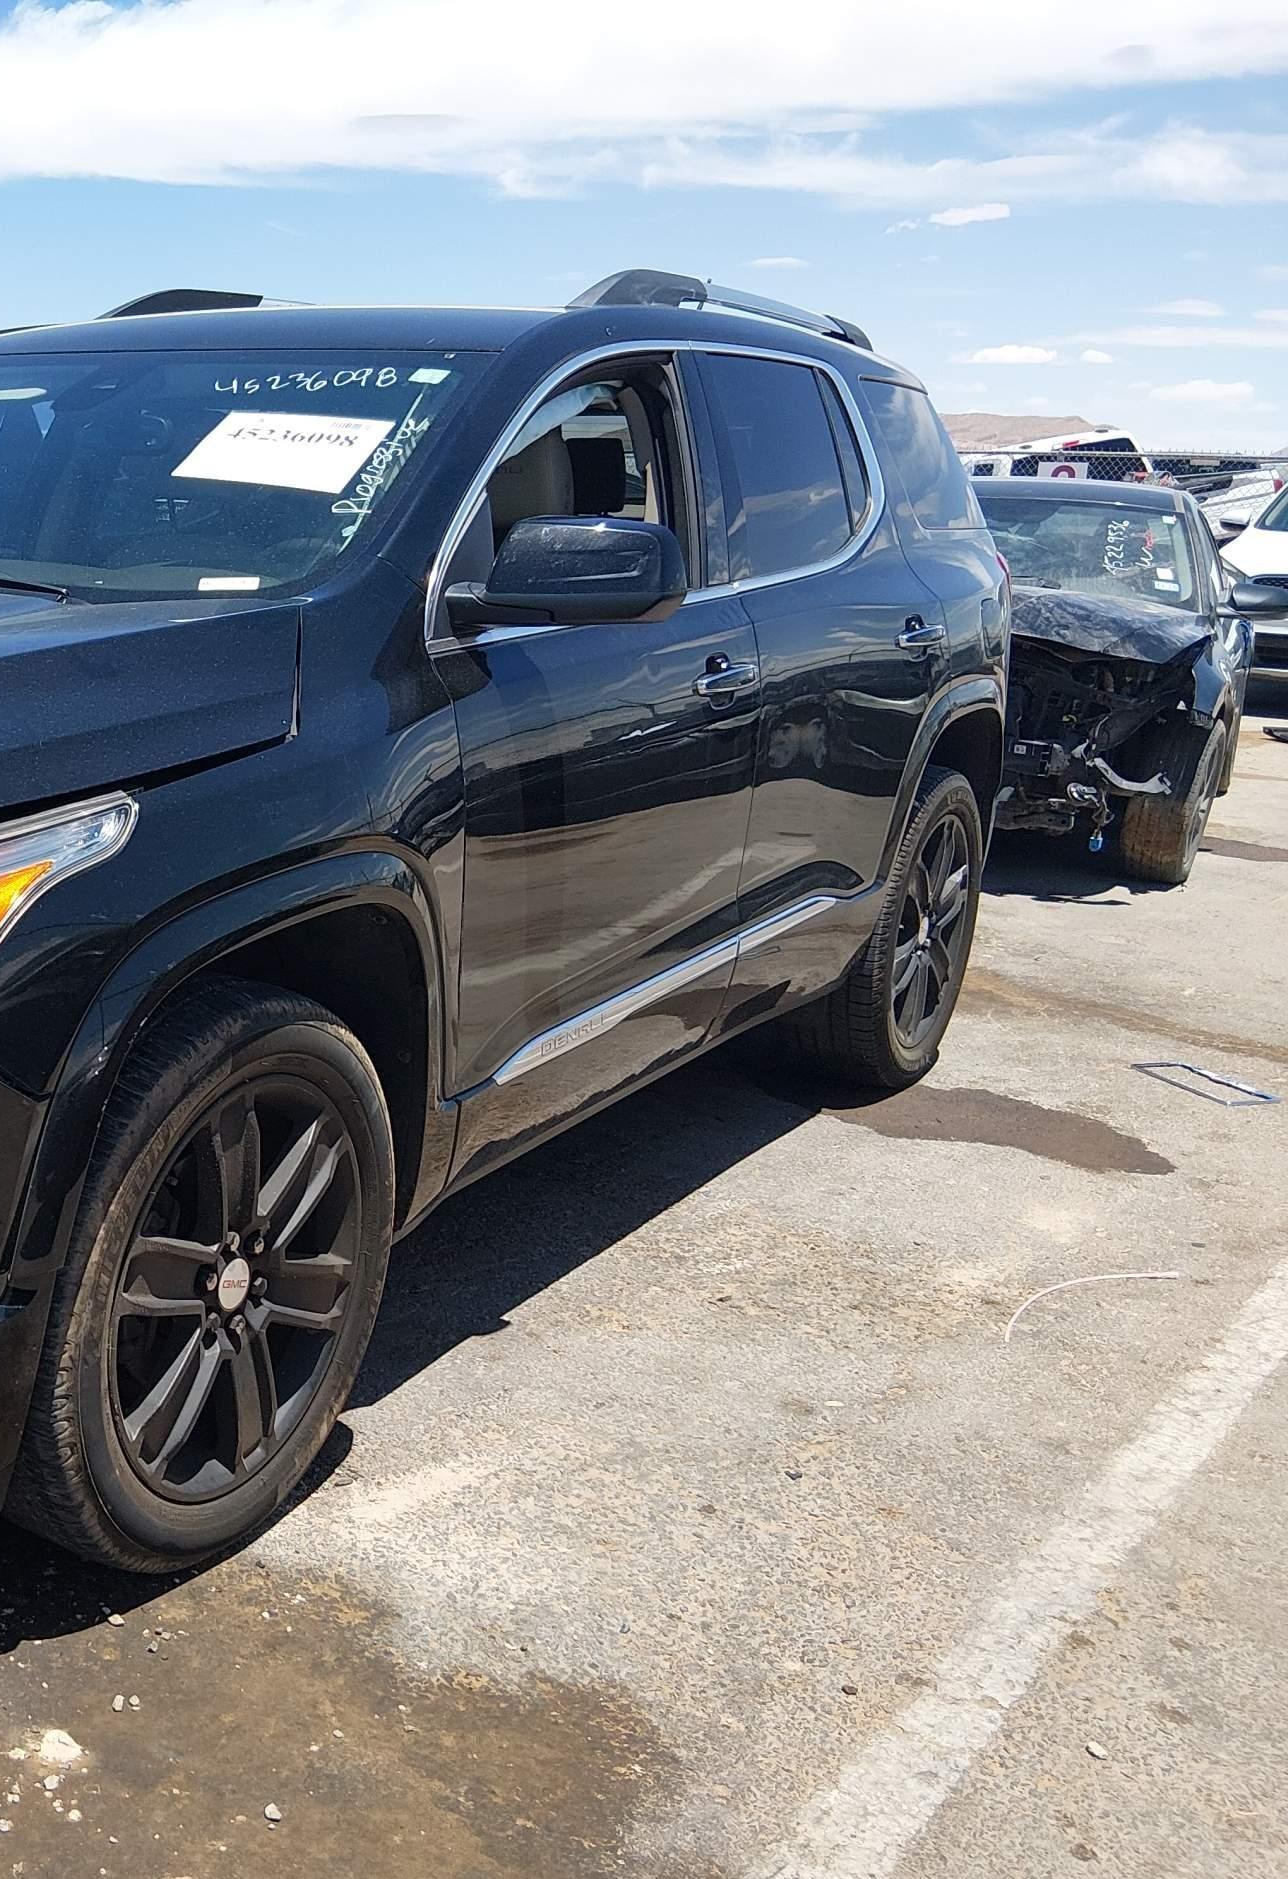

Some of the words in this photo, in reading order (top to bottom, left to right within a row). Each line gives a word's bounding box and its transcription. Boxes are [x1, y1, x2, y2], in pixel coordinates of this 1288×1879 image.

[228, 427, 358, 447] 45236098
[540, 1013, 605, 1056] DENALI
[222, 1279, 247, 1289] GMC
